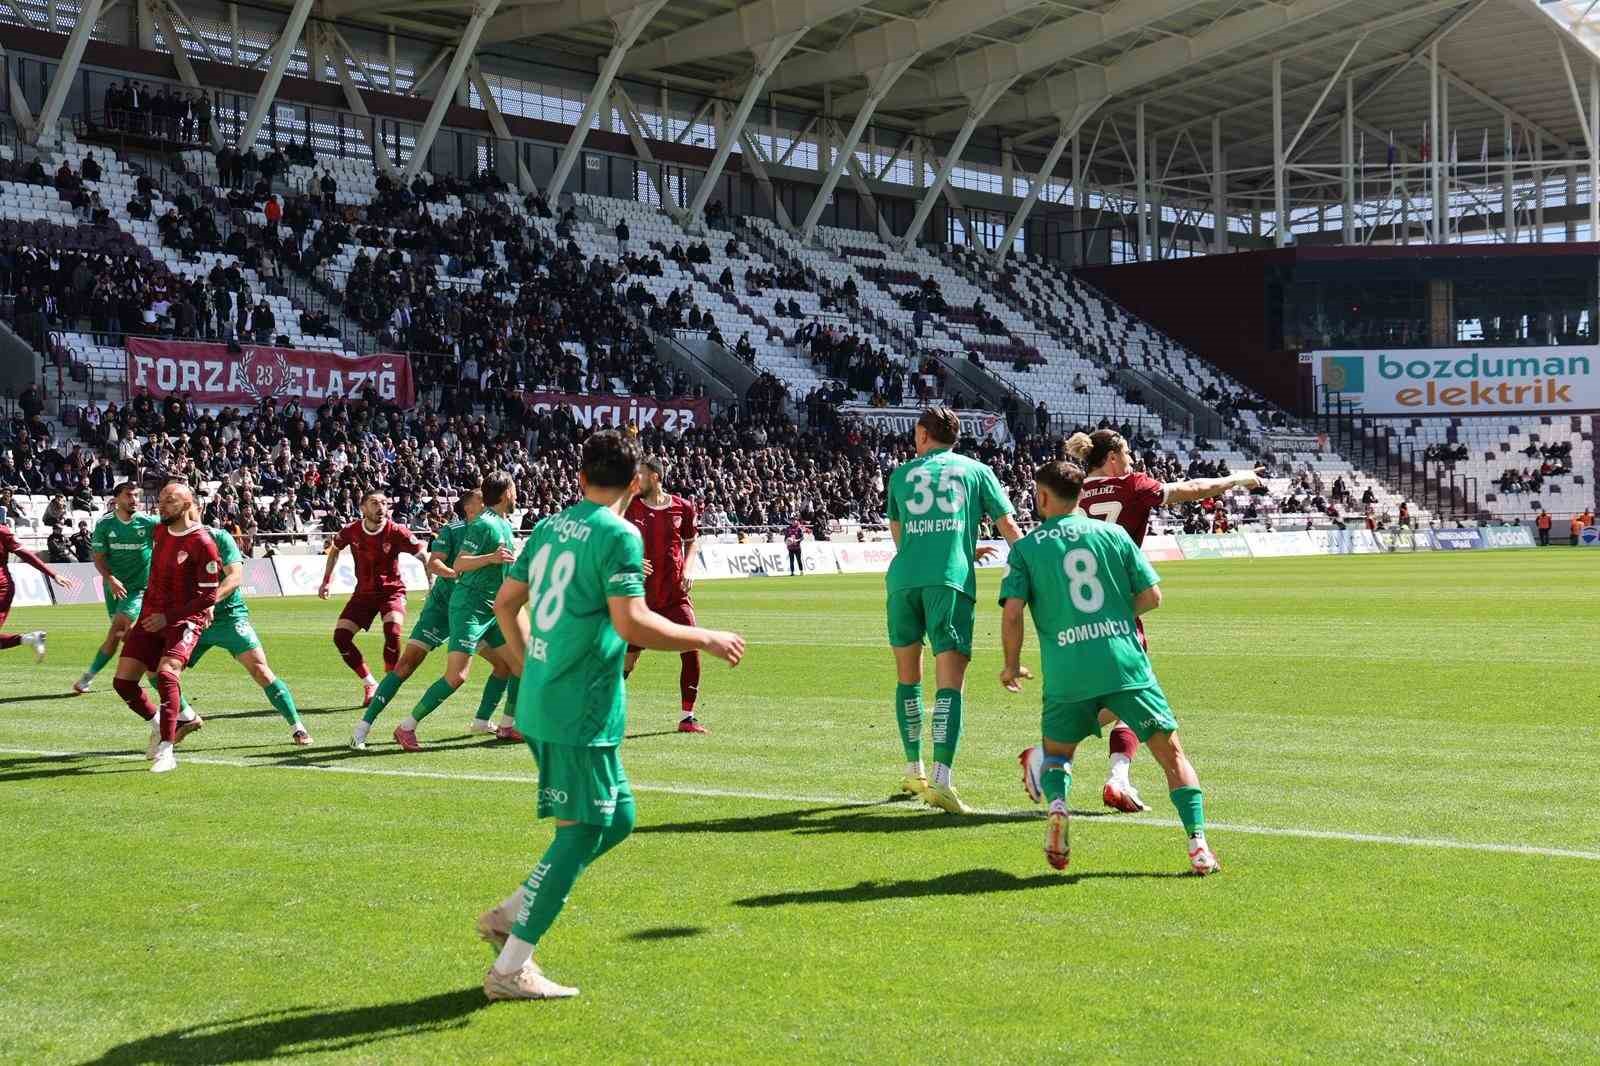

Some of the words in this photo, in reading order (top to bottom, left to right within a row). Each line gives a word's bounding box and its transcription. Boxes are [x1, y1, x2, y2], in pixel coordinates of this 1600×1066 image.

[134, 354, 251, 393] FORZA
[256, 364, 273, 386] 23
[1377, 353, 1590, 380] bozduman
[1395, 379, 1574, 407] elektrik
[662, 409, 695, 432] 23
[905, 466, 966, 516] 35
[528, 543, 576, 631] 48
[1063, 549, 1105, 613] 8
[1057, 618, 1131, 647] SOMUNCU
